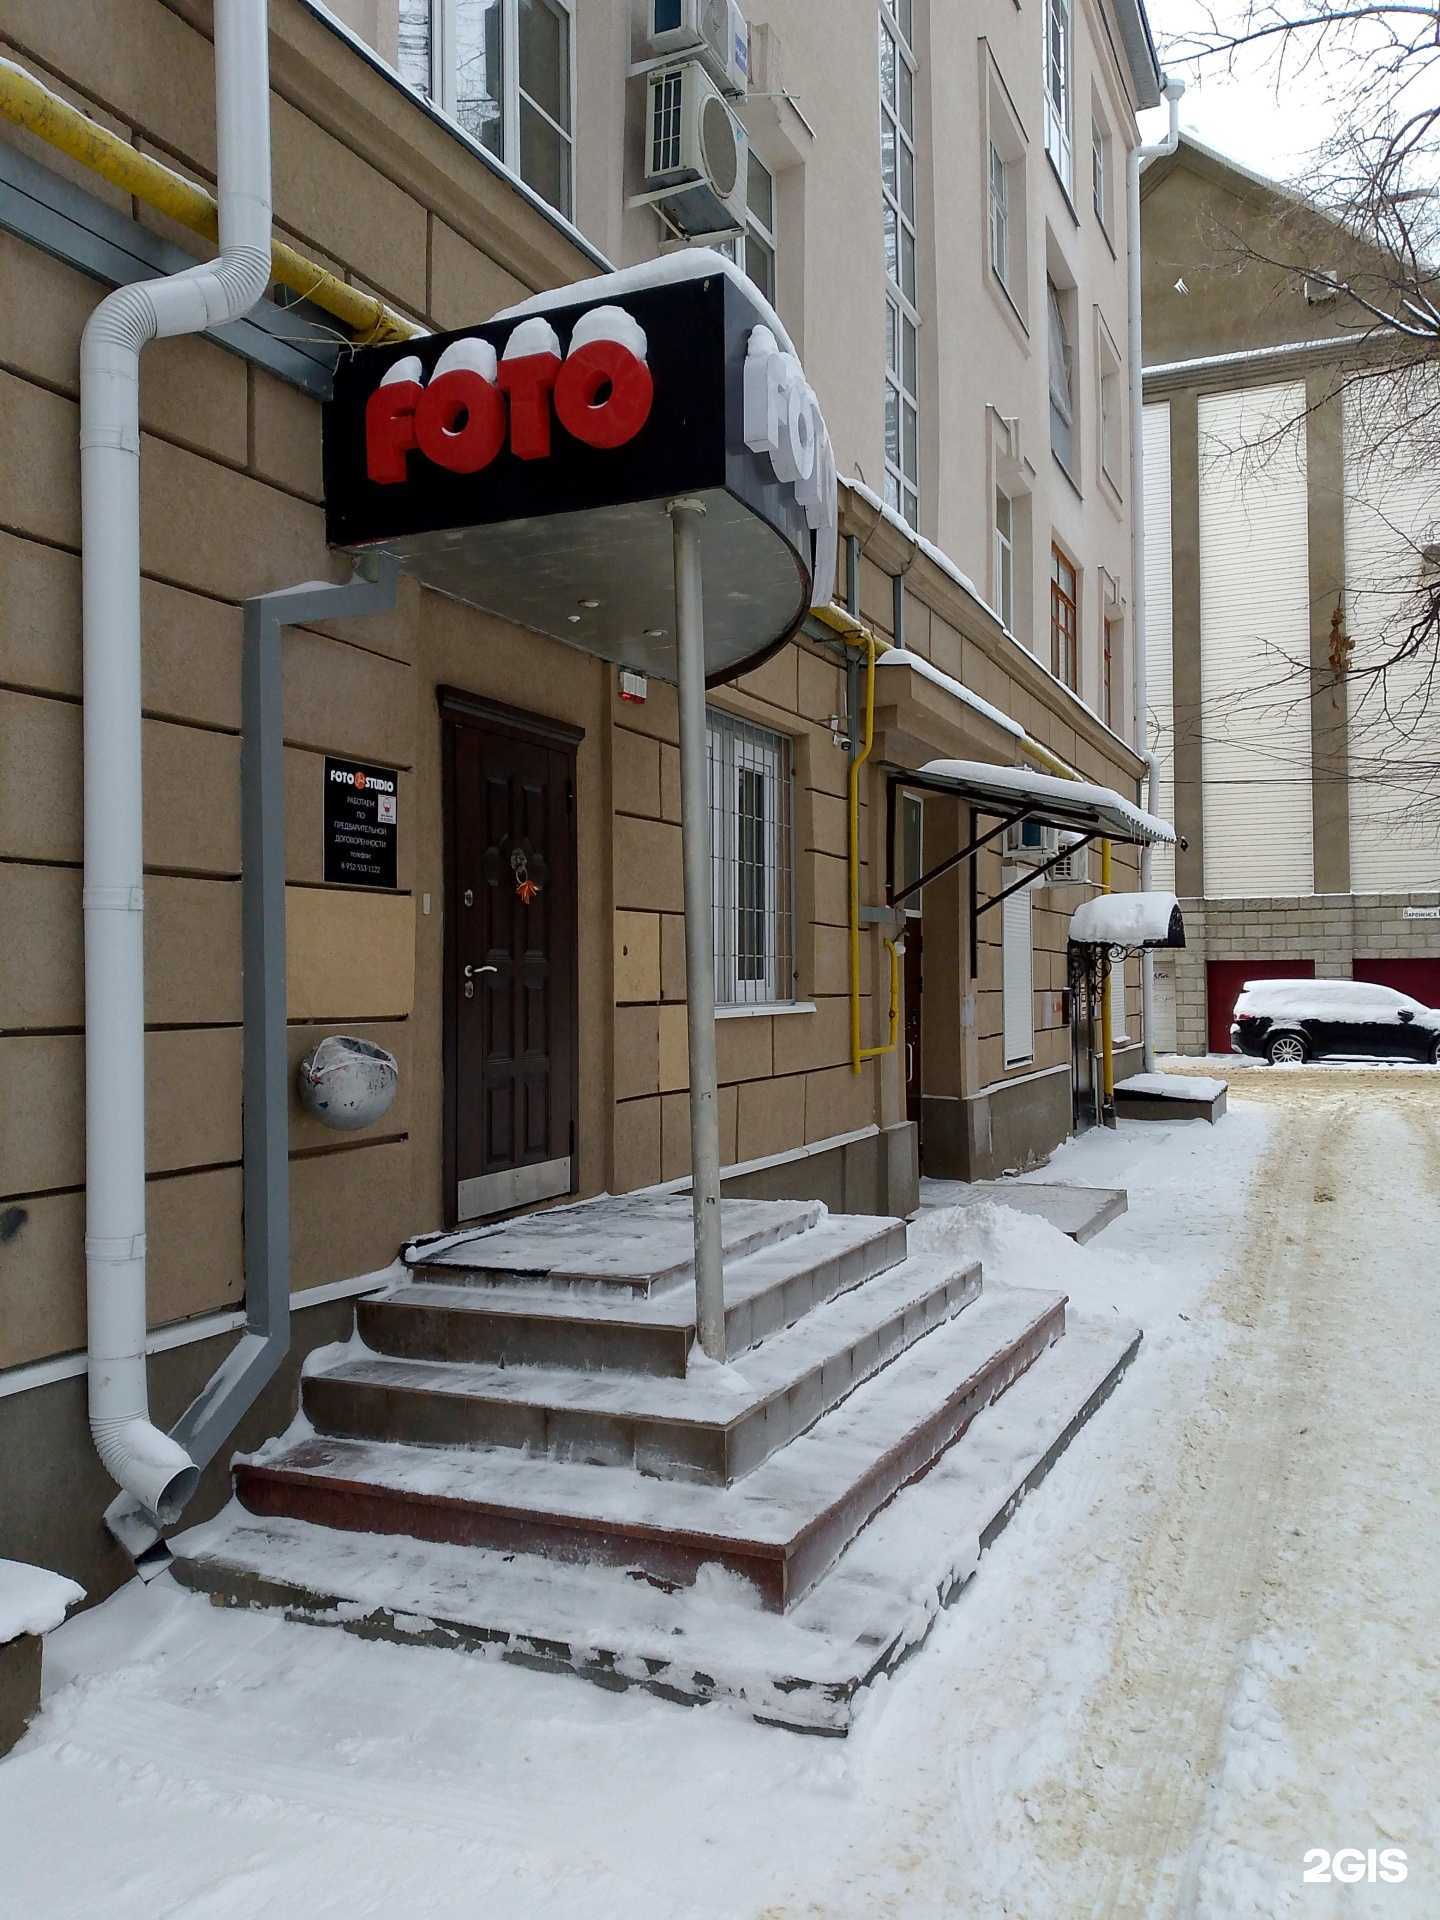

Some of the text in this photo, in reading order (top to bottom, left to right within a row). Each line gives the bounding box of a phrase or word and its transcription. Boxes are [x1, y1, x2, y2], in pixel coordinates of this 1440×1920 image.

[366, 339, 654, 485] FOTO
[330, 769, 394, 793] FOTO STUDIO
